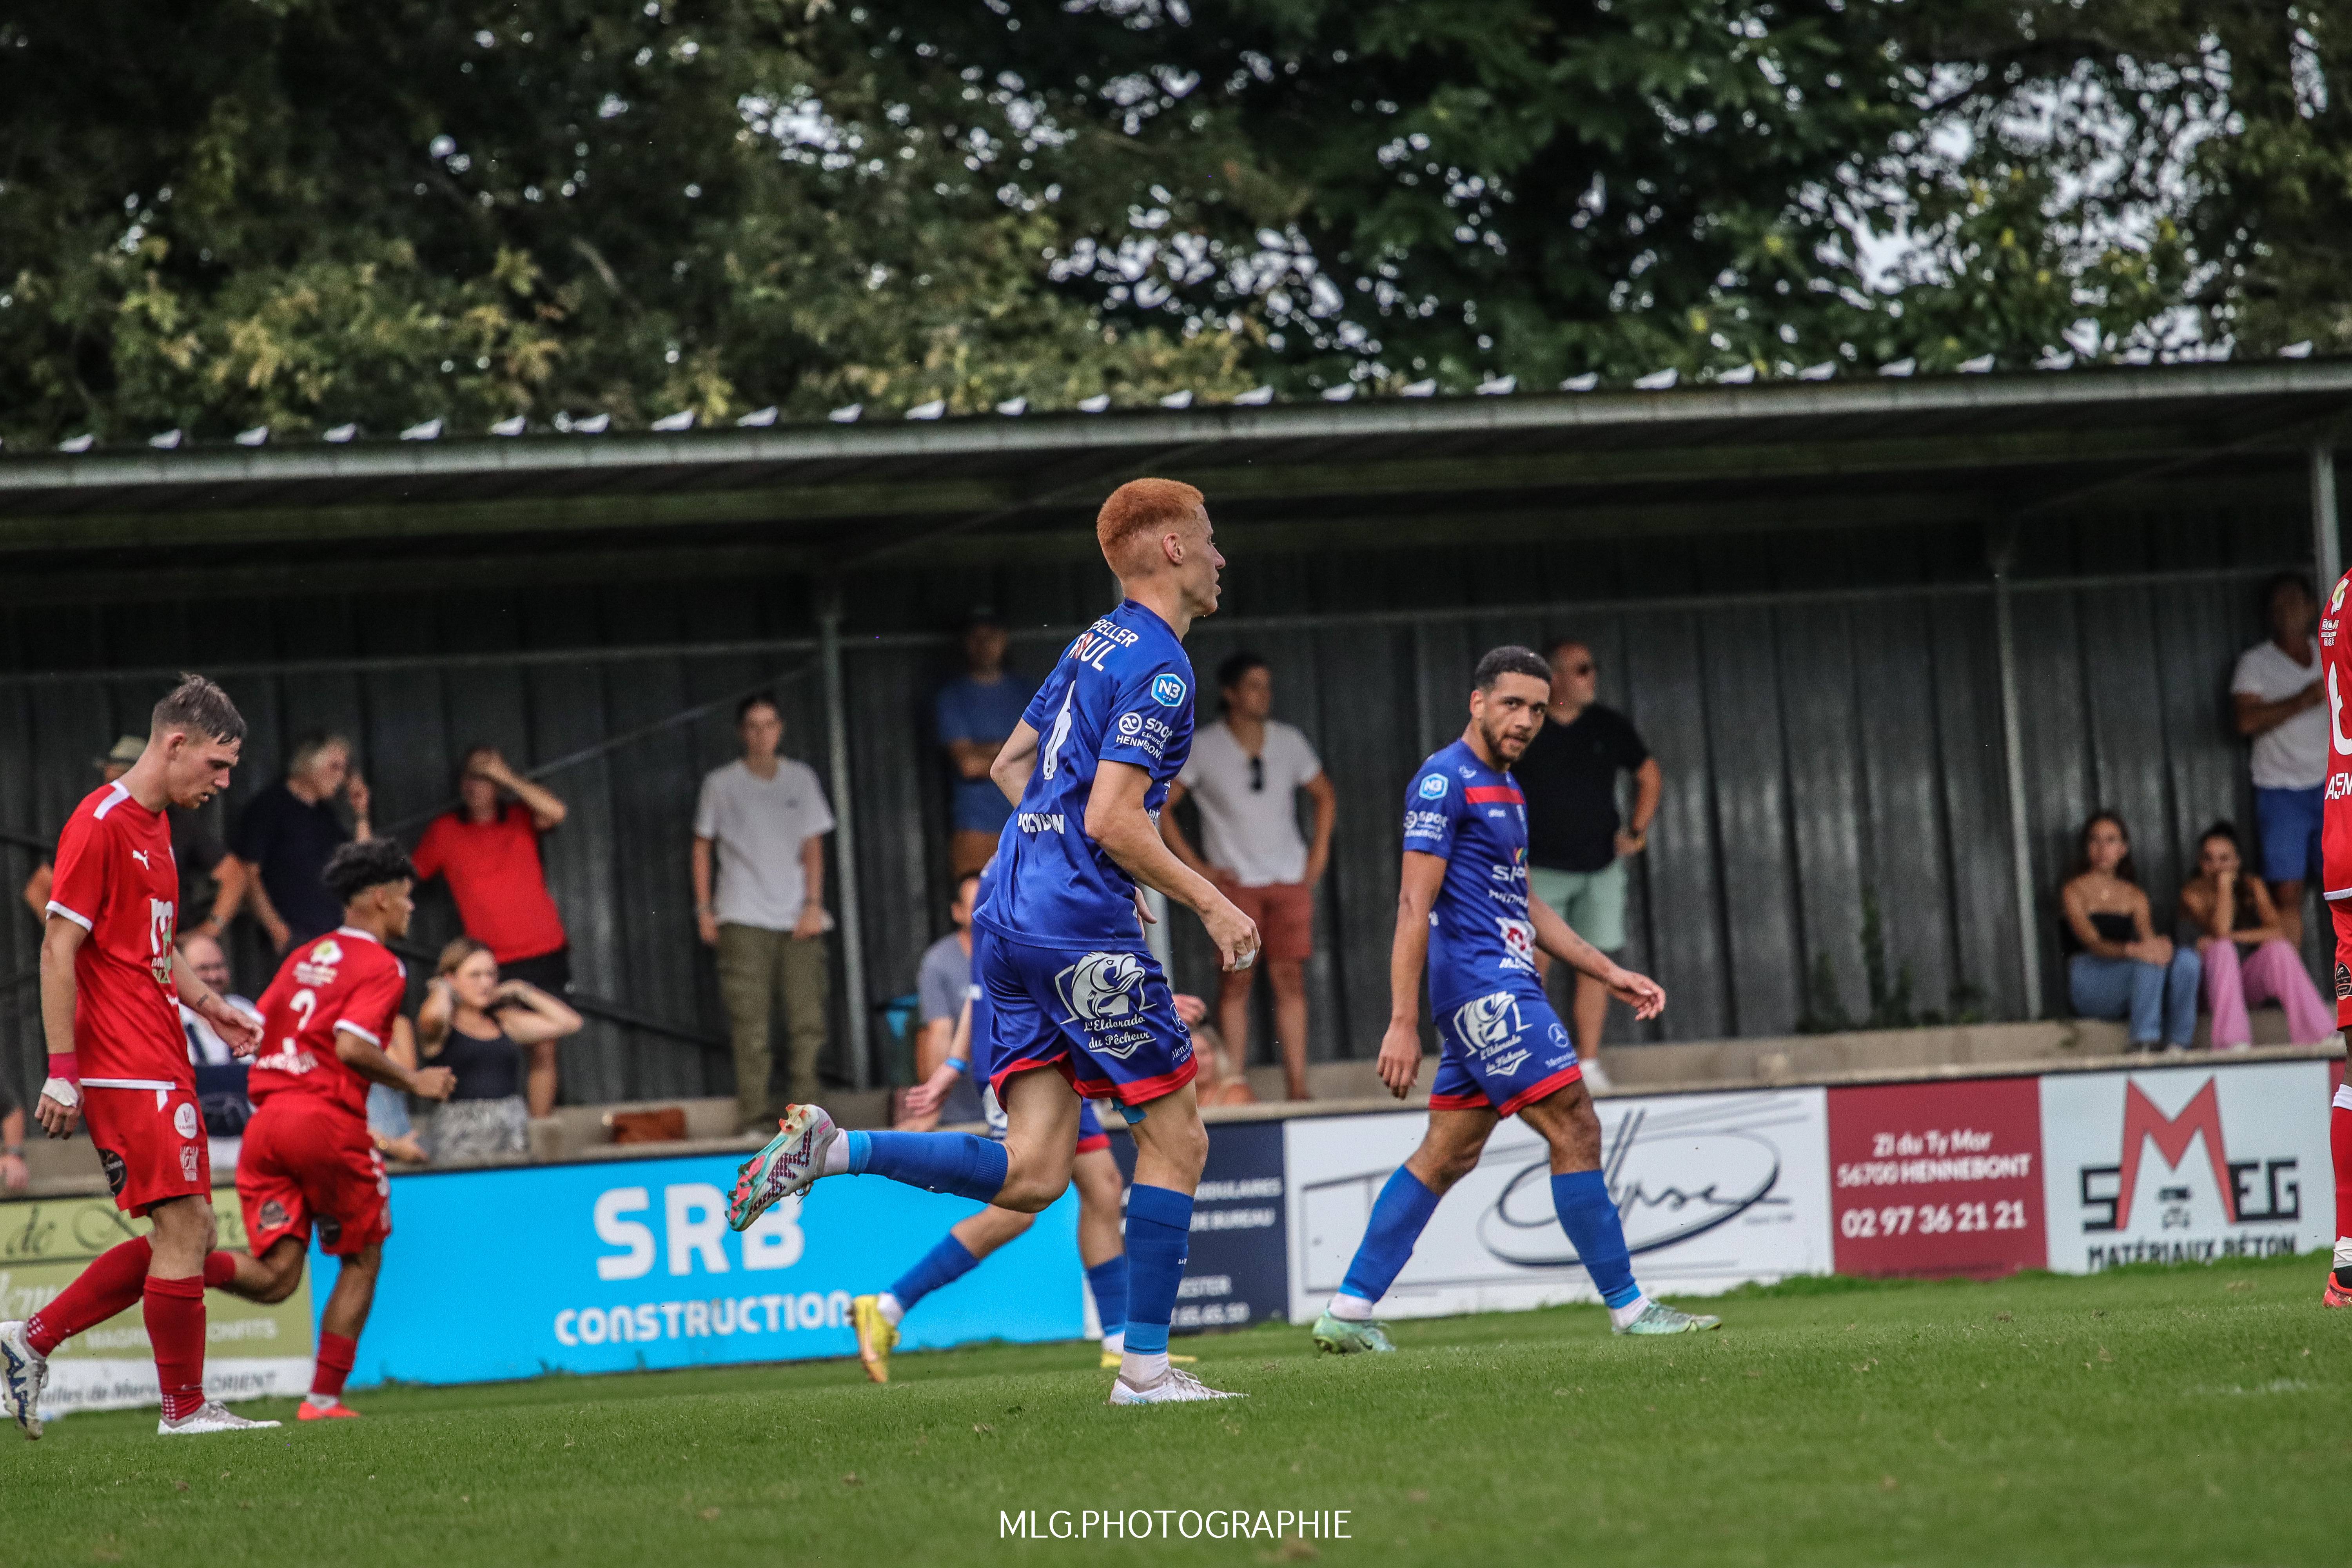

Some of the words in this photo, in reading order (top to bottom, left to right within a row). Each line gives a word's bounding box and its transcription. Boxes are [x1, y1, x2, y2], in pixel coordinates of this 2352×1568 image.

[1158, 679, 1180, 698] N3
[1116, 735, 1162, 760] HENNBON
[1083, 1013, 1145, 1032] L'Eldorado
[1089, 1036, 1103, 1049] du
[1105, 1031, 1150, 1045] Pêcheur
[1896, 1131, 1924, 1156] du
[1924, 1129, 1951, 1157] Ty
[1950, 1128, 1994, 1152] Mor
[1899, 1152, 2032, 1184] HENNEBONT
[593, 1182, 806, 1282] SRB
[1841, 1207, 1878, 1239] 02
[1879, 1205, 1916, 1237] 97
[1918, 1203, 1954, 1234] 36
[1956, 1201, 1990, 1232] 21
[1993, 1199, 2027, 1230] 21
[554, 1289, 851, 1347] CONSTRUCTION
